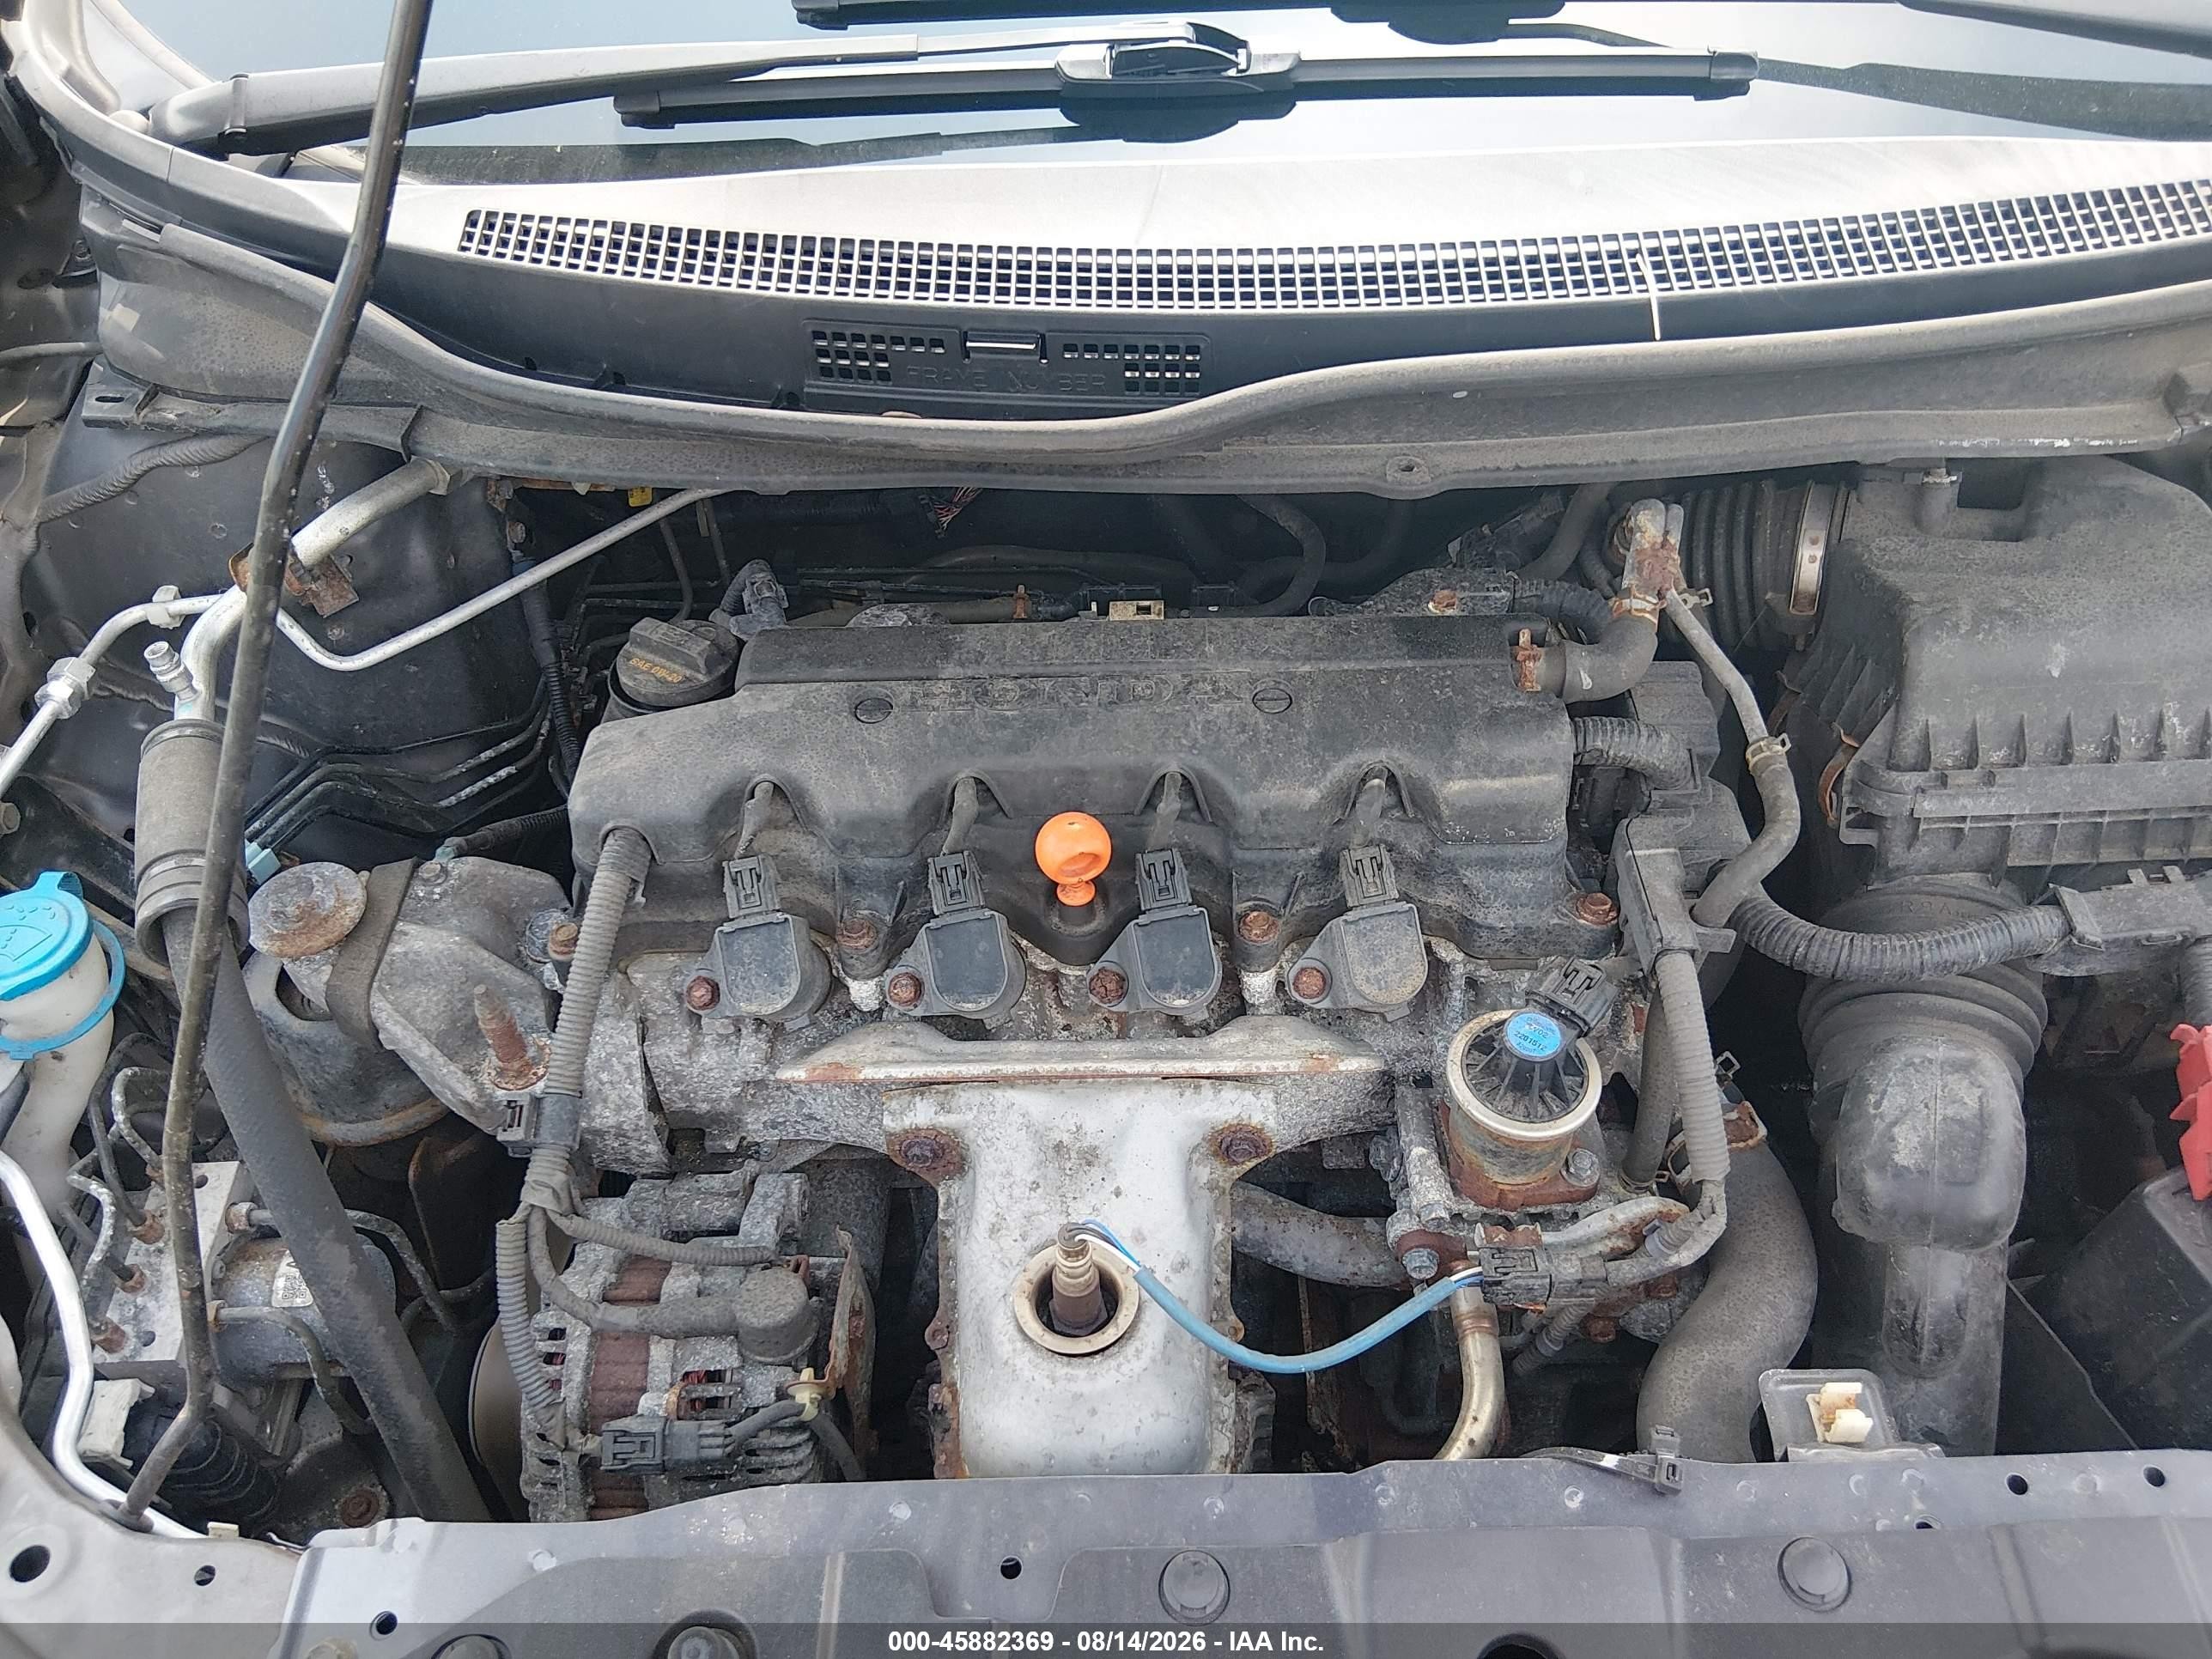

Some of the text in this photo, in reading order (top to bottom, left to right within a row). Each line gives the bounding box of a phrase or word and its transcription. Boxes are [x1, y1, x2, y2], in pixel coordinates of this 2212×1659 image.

[906, 364, 988, 386] FRAME
[629, 658, 683, 683] SAE 0W-20
